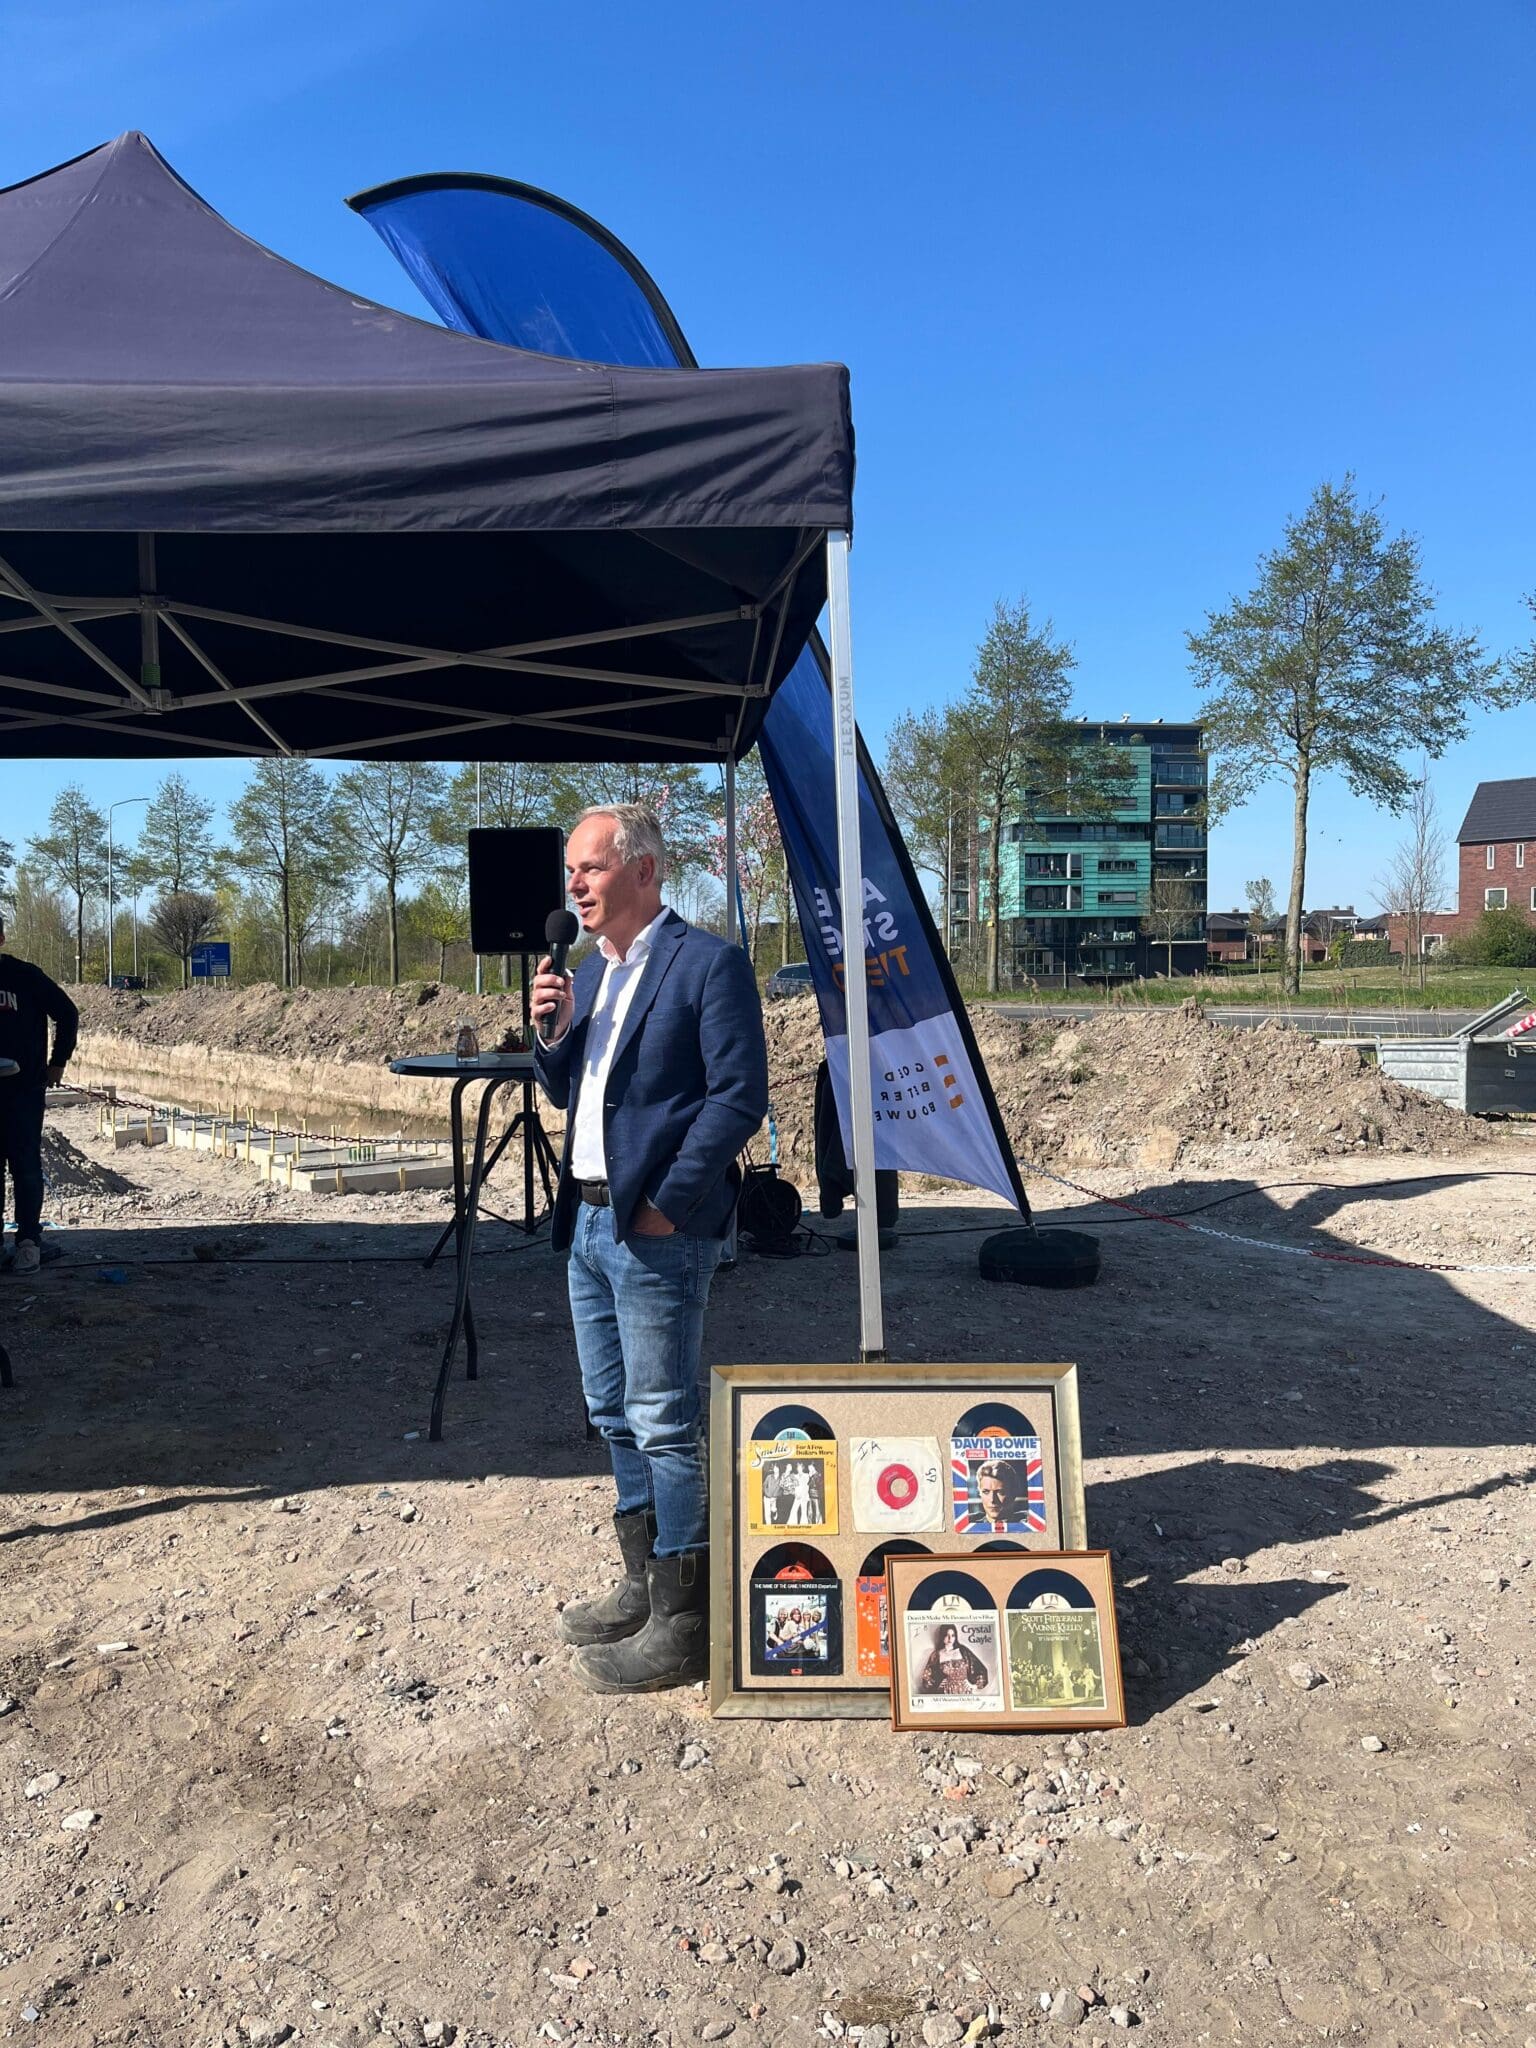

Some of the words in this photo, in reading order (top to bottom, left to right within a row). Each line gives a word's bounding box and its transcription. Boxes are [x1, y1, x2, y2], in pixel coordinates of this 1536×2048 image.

[839, 676, 854, 757] FLEXXUM
[954, 1438, 992, 1449] DAVID
[995, 1438, 1037, 1449] BOWIE
[990, 1449, 1027, 1459] heroes
[961, 1624, 992, 1636] Crystal
[968, 1634, 992, 1646] Gayle
